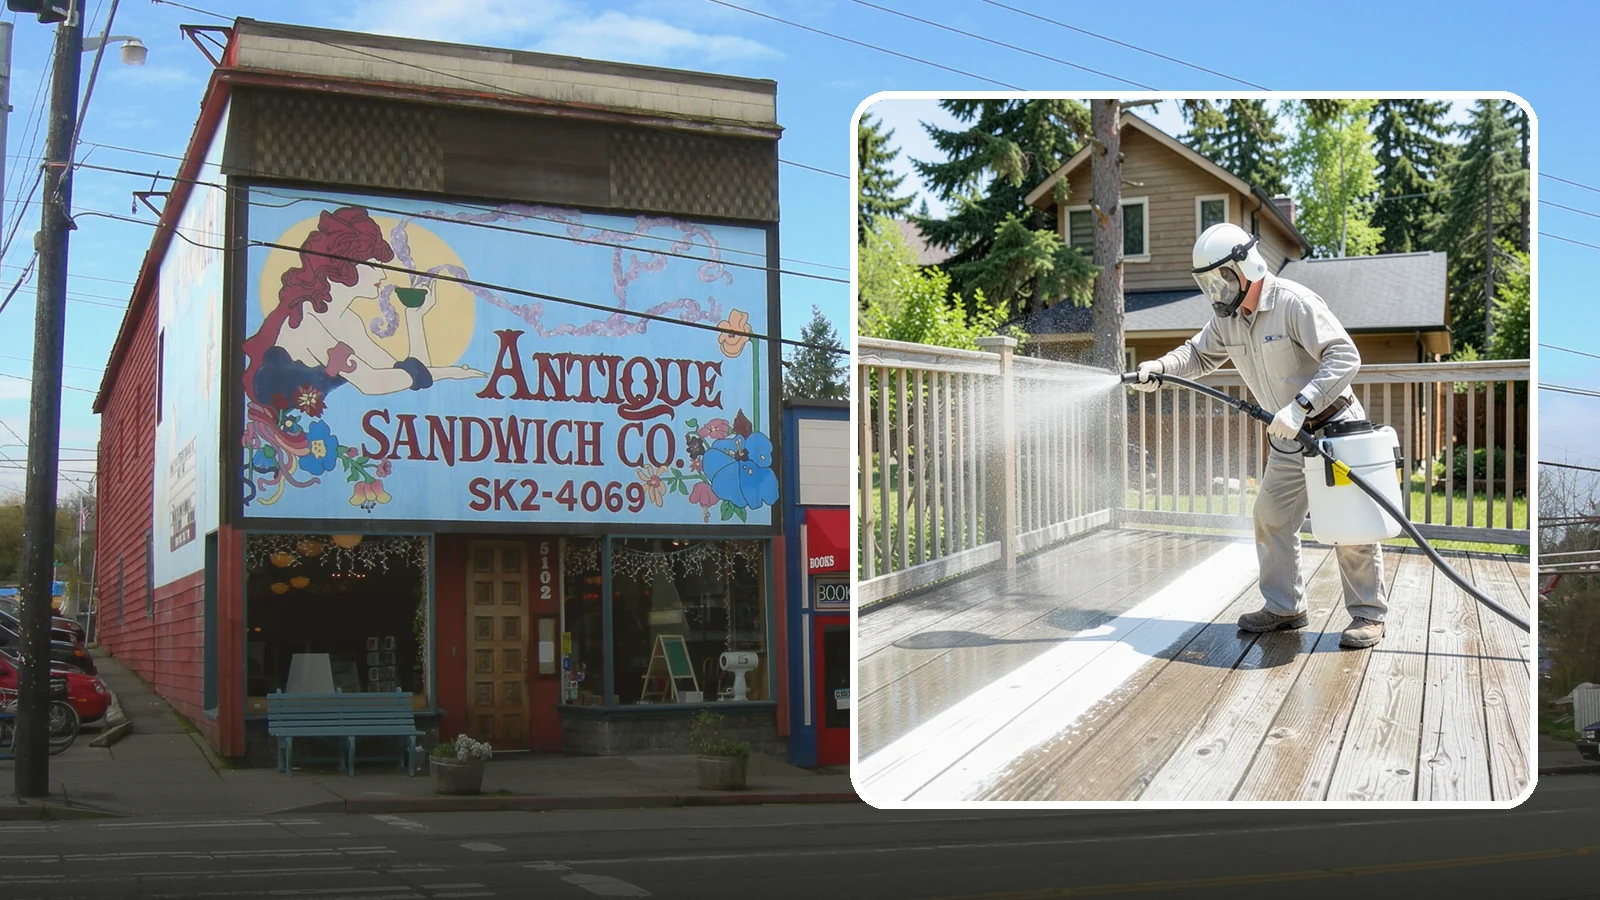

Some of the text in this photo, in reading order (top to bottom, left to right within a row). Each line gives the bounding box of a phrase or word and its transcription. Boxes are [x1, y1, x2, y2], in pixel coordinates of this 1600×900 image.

[475, 329, 724, 421] ANTIQUE
[361, 408, 685, 468] SANDWICH CO.
[468, 477, 645, 513] SK2-4069
[540, 541, 551, 600] 5102
[809, 555, 834, 569] BOOKS
